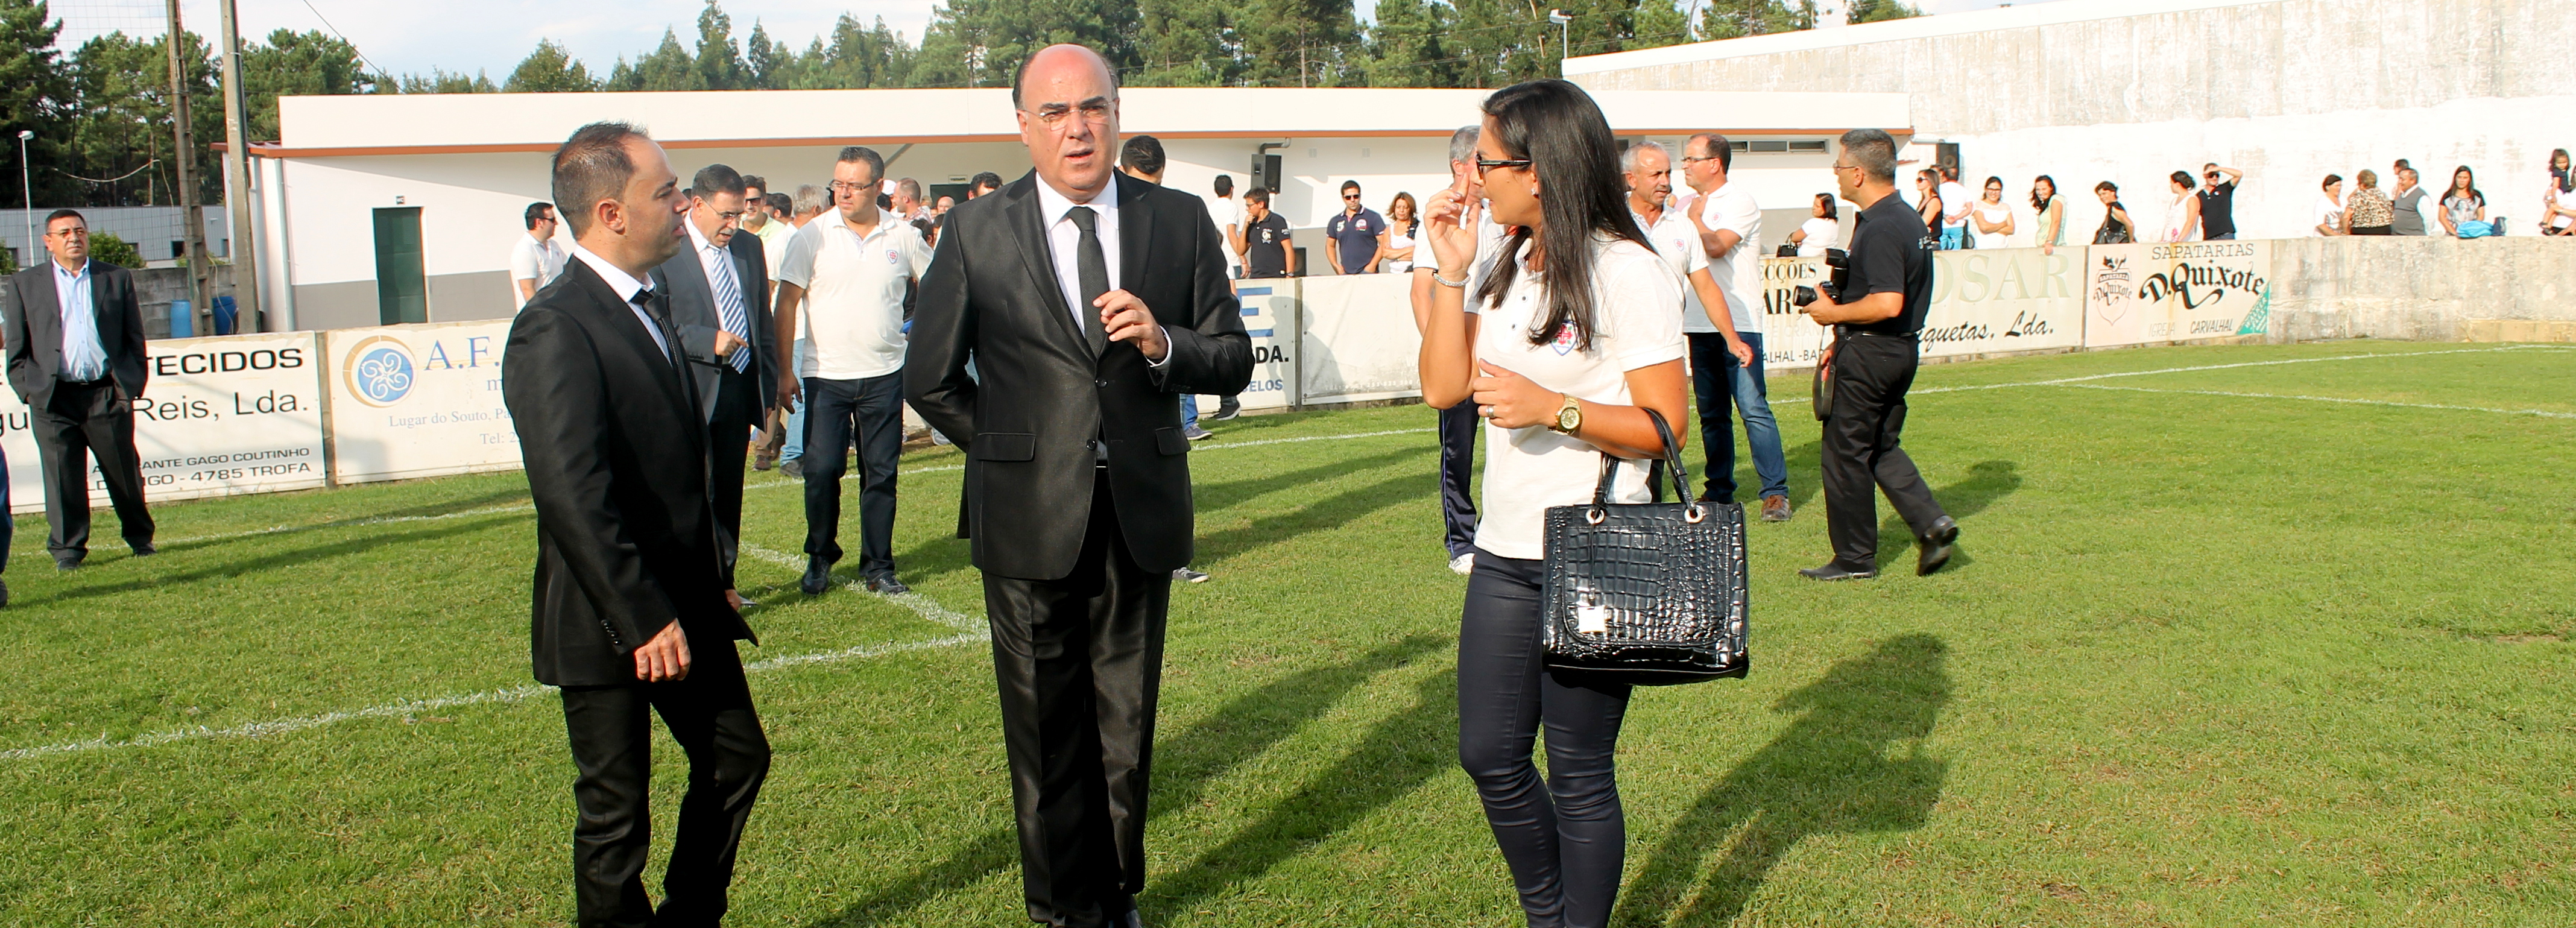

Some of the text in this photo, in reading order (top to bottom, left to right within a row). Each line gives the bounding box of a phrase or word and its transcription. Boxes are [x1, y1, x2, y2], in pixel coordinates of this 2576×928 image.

[2151, 243, 2254, 260] SAPATARIAS
[2004, 310, 2054, 338] Lda.
[2148, 318, 2233, 337] IGREJA CARVALHAL
[145, 349, 303, 376] ECIDOS
[424, 336, 500, 371] A.F.
[1255, 345, 1289, 364] DA.
[133, 395, 219, 421] Reis,
[234, 390, 308, 415] Lda.
[389, 415, 427, 429] Lugar
[431, 412, 447, 423] do
[451, 411, 491, 423] Souto,
[479, 432, 505, 445] Tel:
[186, 454, 229, 466] GAGO
[233, 447, 310, 462] COUTINHO
[191, 468, 244, 482] 4785
[248, 462, 311, 477] TROFA
